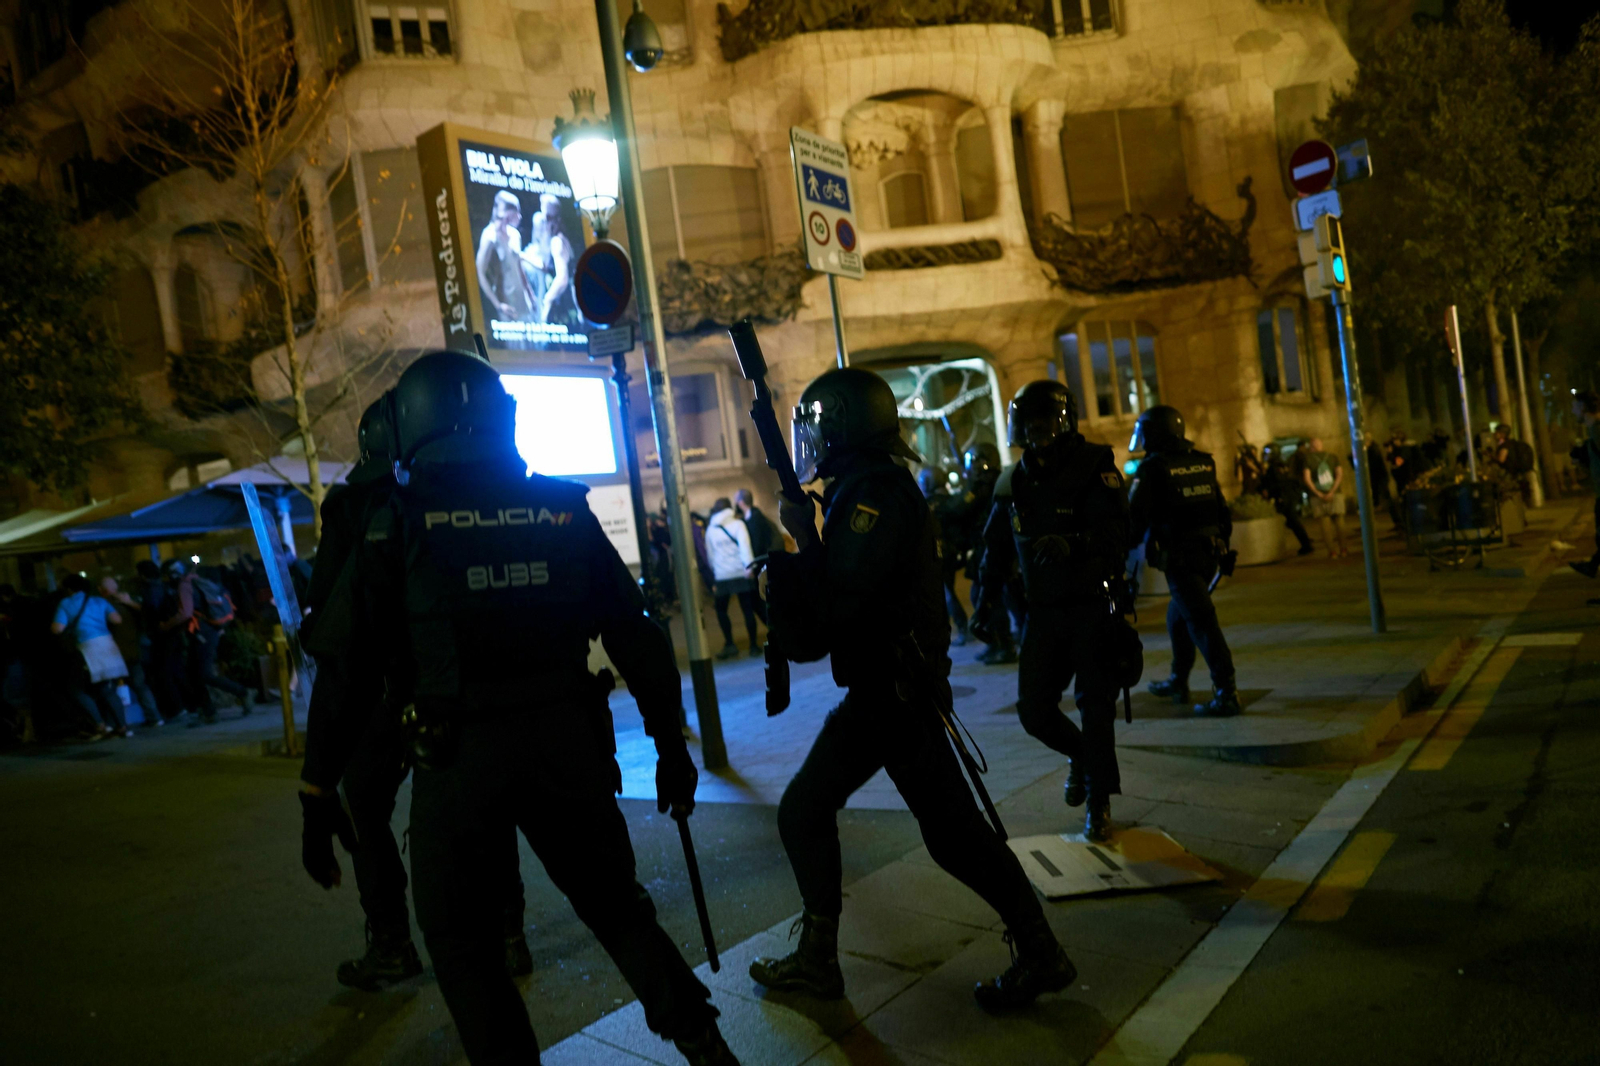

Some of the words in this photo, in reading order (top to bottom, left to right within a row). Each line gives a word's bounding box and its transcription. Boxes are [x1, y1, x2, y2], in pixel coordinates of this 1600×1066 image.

[794, 132, 811, 146] Zona
[466, 149, 501, 172] BILL
[500, 155, 545, 181] VIOLA
[814, 221, 824, 234] 10
[435, 188, 460, 304] Pedrera
[1170, 464, 1208, 476] POLICIA
[424, 507, 556, 531] POLICIA
